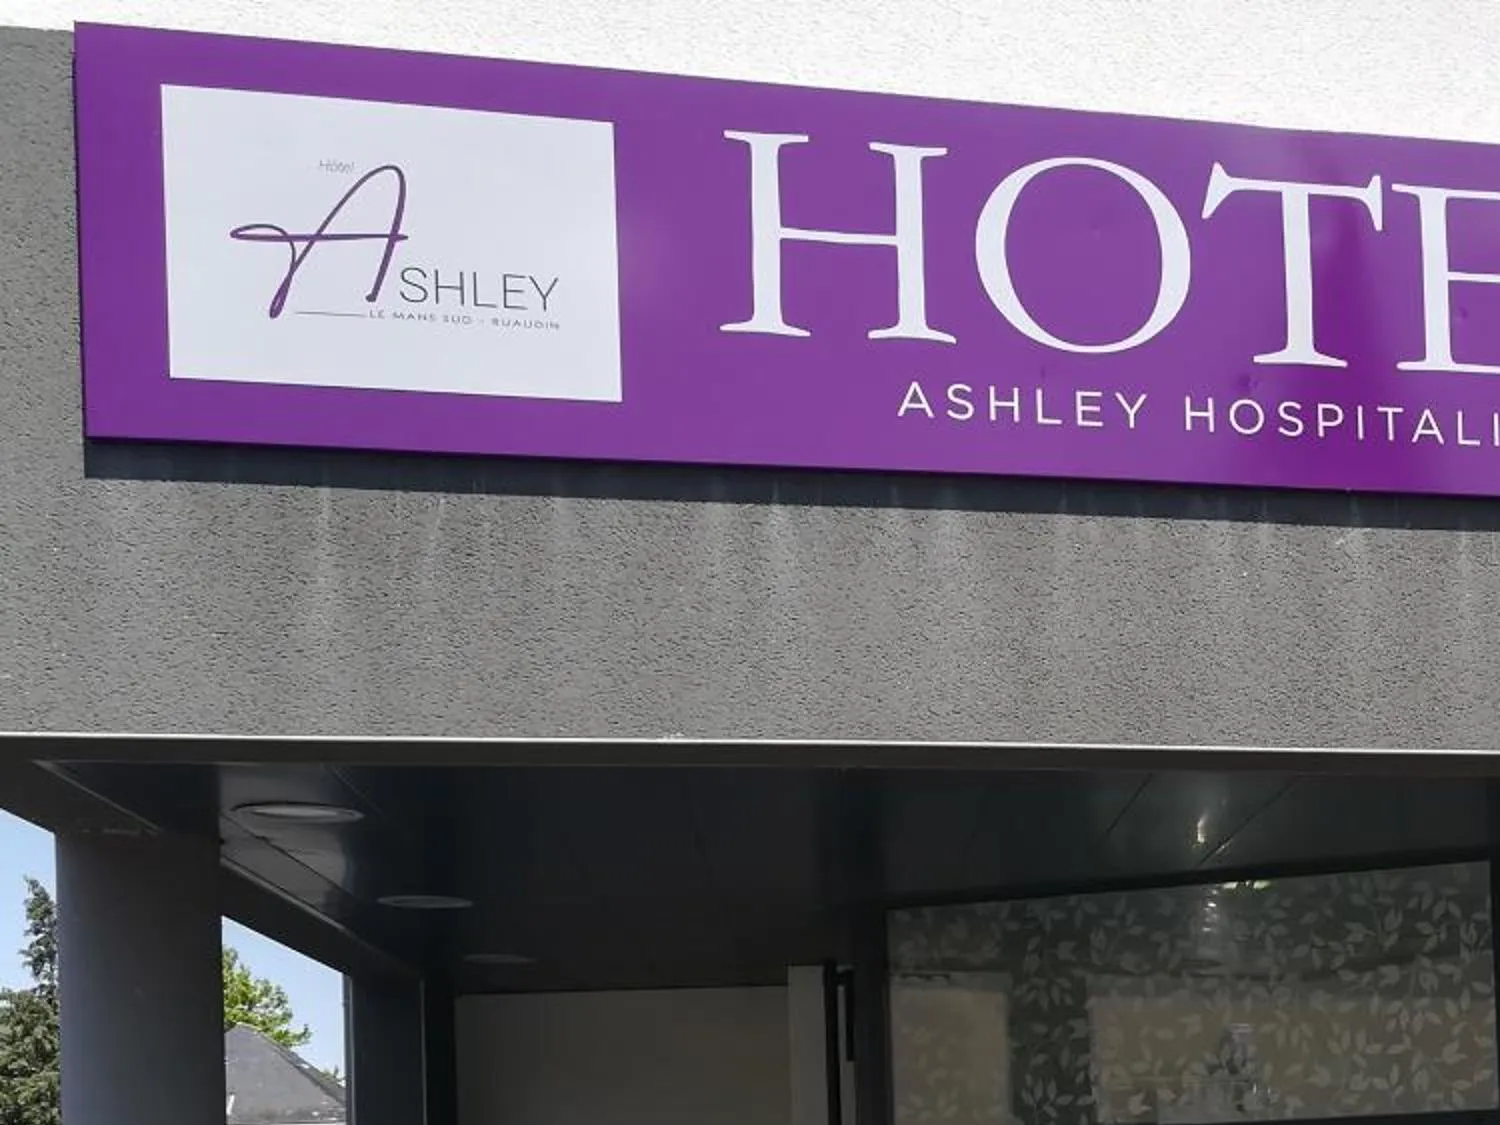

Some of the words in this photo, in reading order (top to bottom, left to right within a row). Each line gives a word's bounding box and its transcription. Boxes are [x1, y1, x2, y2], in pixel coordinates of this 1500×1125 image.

[369, 309, 386, 319] LE
[393, 312, 436, 323] MANS
[443, 315, 473, 325] SUD
[897, 381, 1147, 429] ASHLEY
